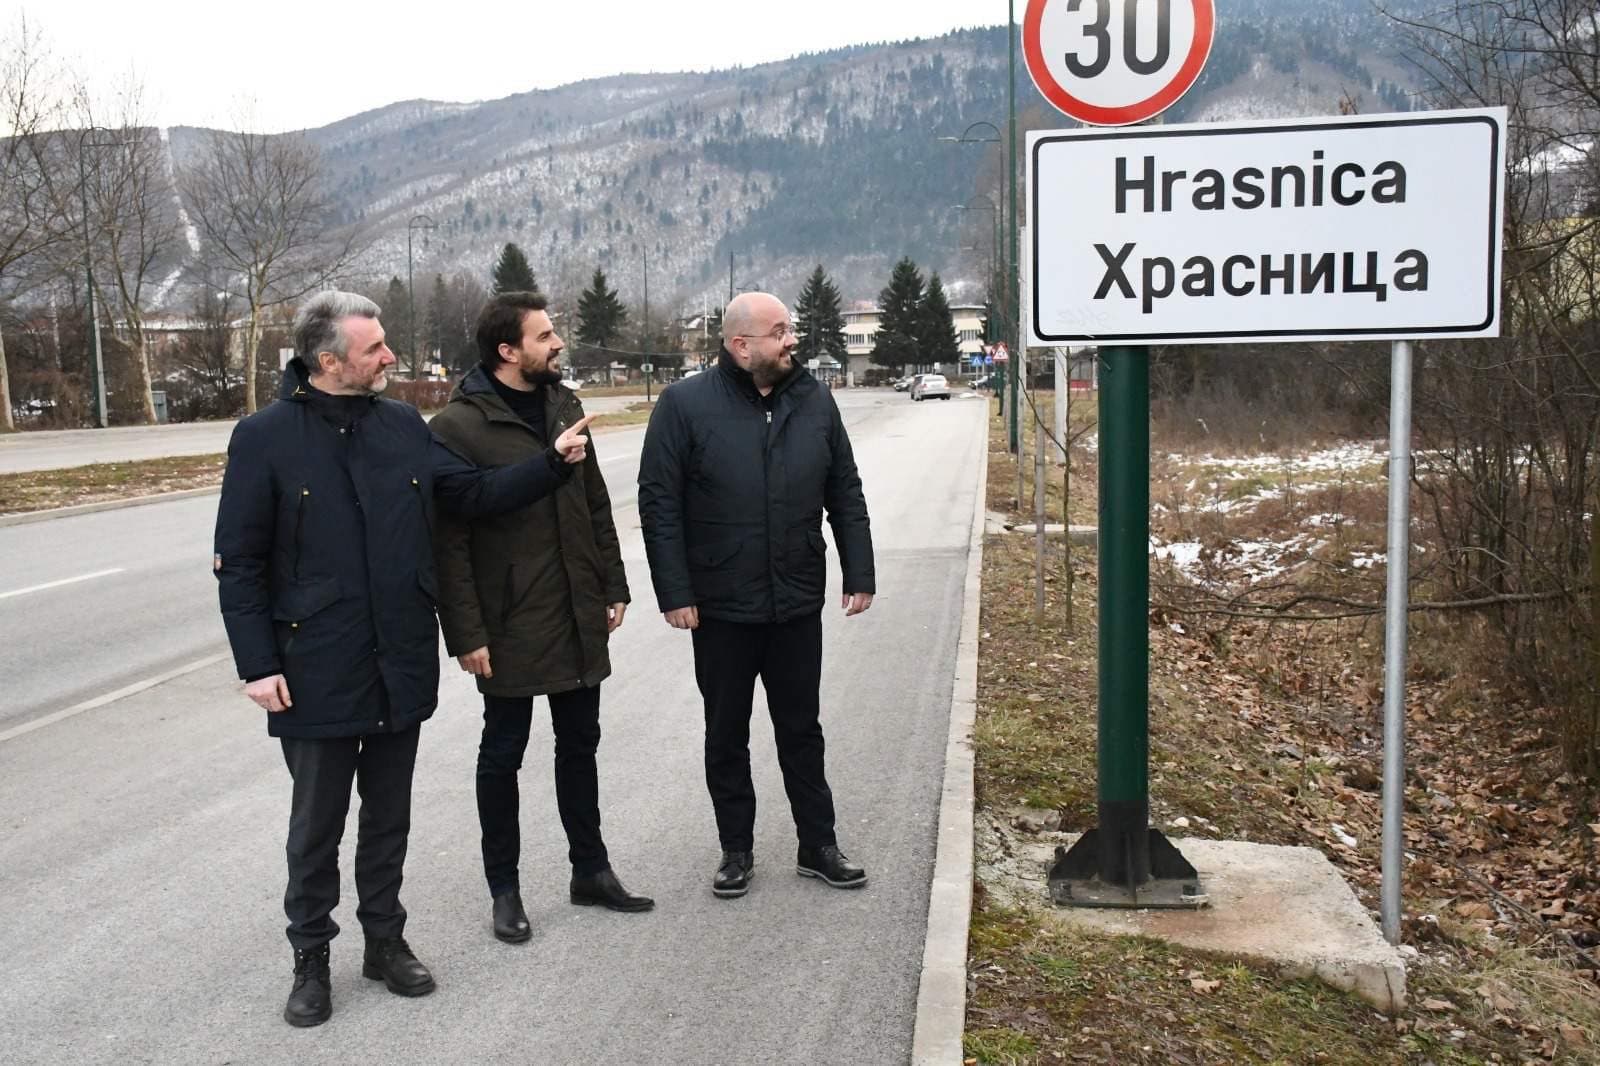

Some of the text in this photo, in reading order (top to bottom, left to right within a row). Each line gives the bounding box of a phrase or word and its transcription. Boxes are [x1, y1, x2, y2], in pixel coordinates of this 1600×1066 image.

[1065, 0, 1170, 78] 30
[1116, 150, 1406, 213] Hrasnica
[1093, 243, 1428, 313] Храсница
